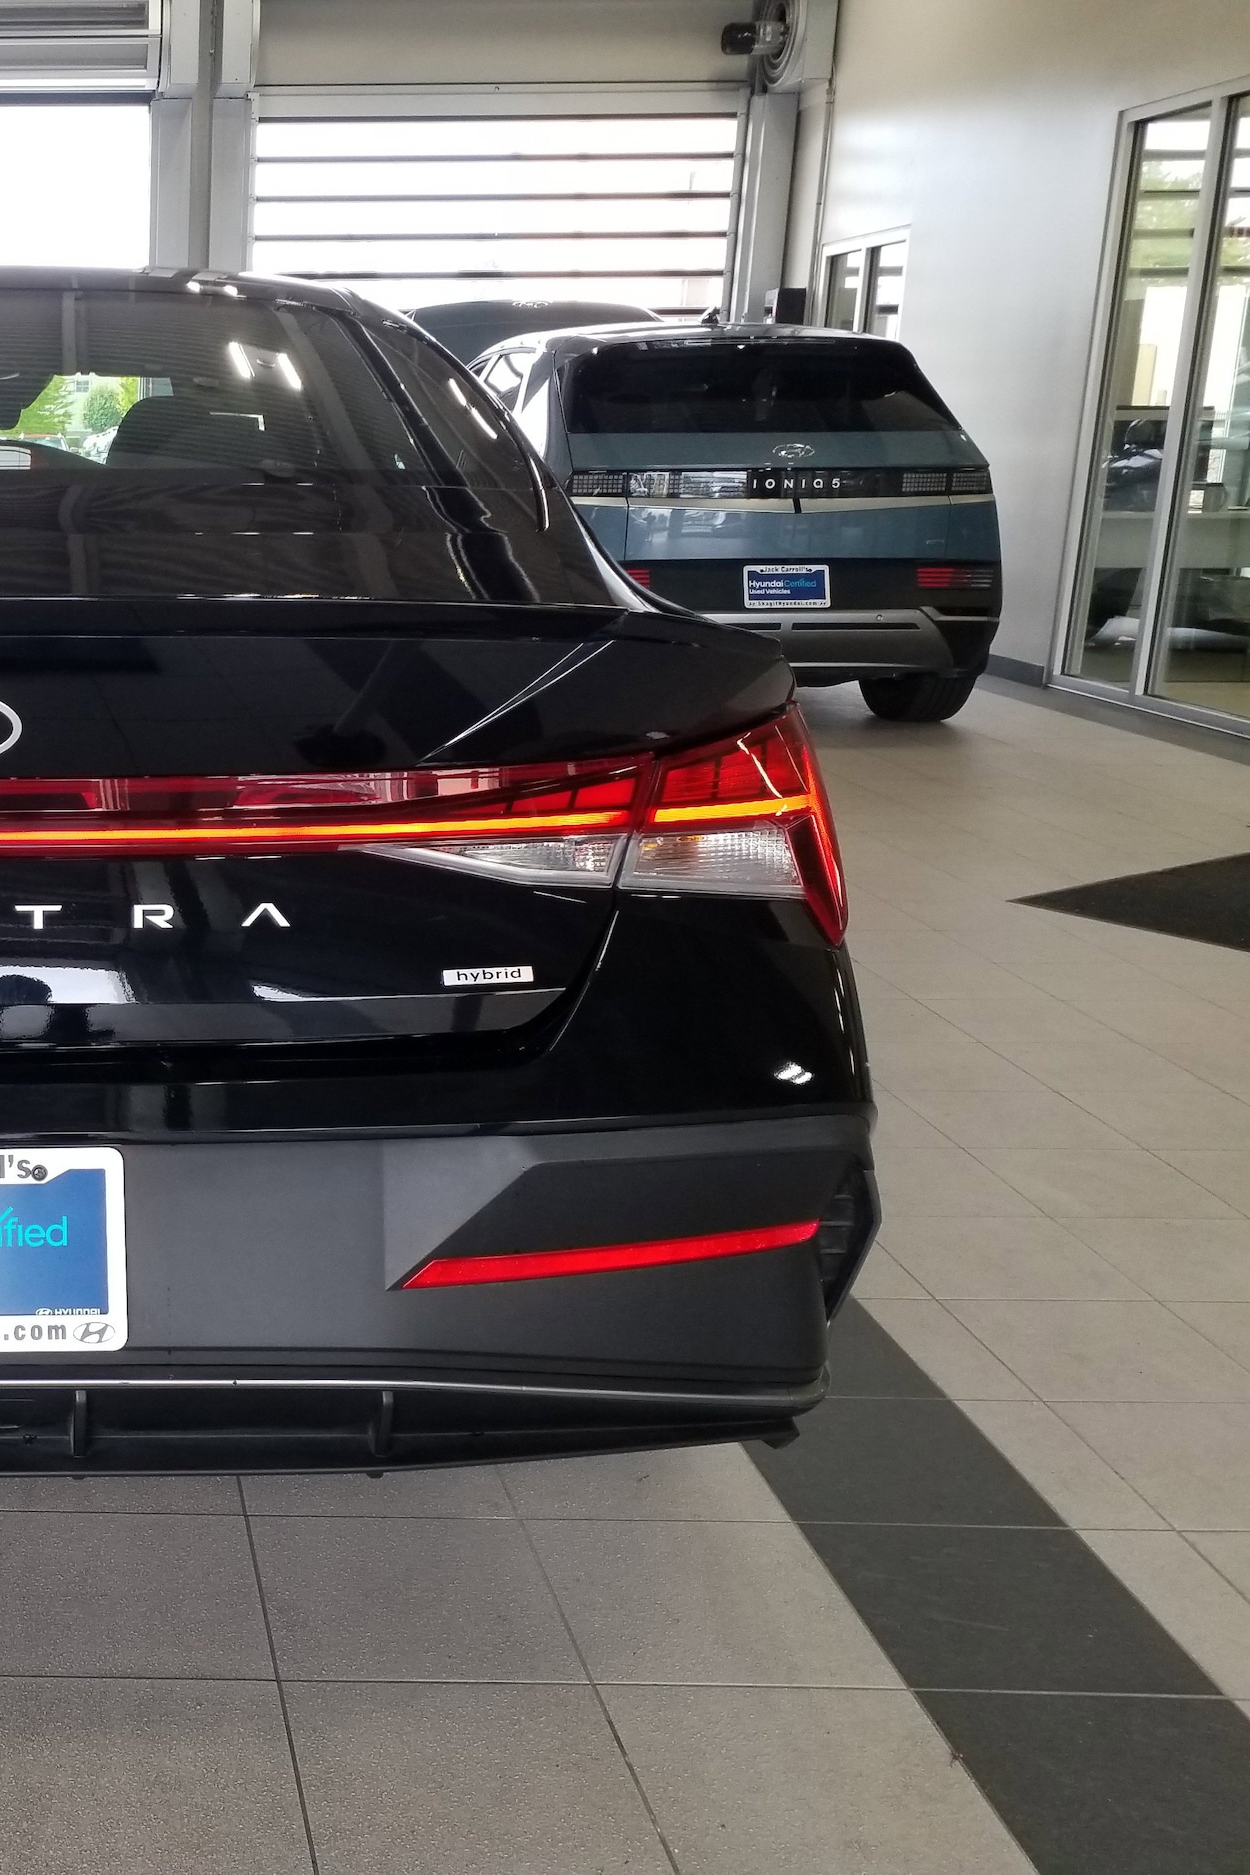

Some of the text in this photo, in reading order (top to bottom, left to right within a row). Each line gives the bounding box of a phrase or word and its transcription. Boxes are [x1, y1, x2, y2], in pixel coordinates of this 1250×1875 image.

[753, 477, 841, 489] IONIQ 5
[749, 578, 817, 589] Hyundai Certified
[457, 968, 522, 982] hybrid
